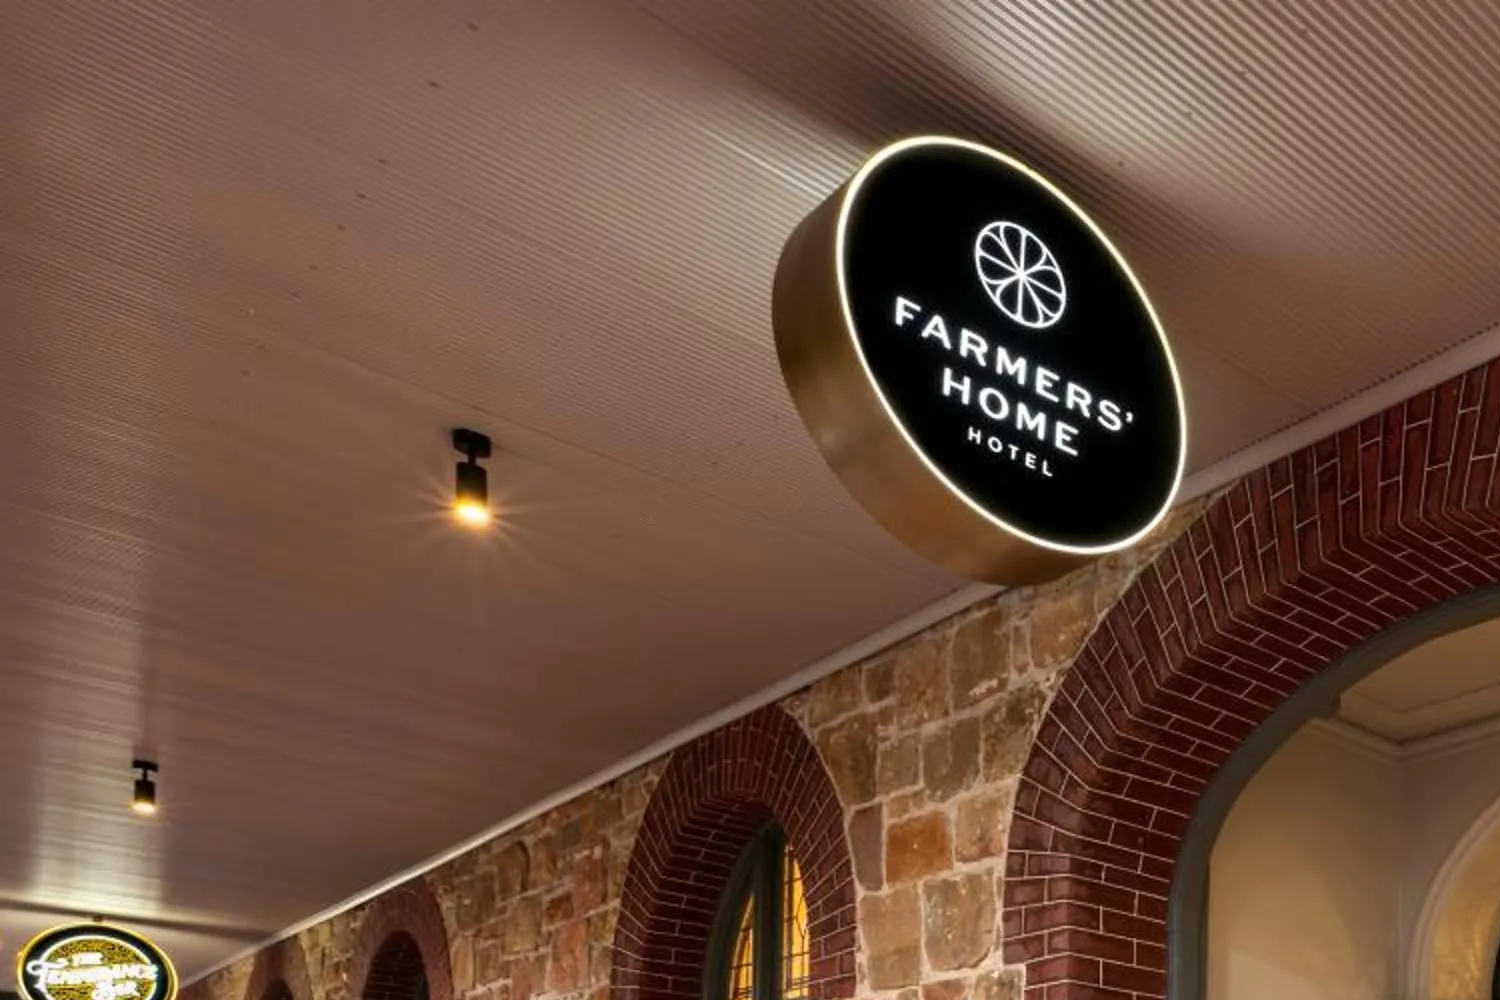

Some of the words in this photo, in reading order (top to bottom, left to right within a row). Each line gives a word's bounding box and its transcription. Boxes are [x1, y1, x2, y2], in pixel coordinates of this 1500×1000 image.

[894, 295, 1134, 432] FARMERS'
[942, 367, 1079, 457] HOME
[967, 426, 1053, 477] HOTEL
